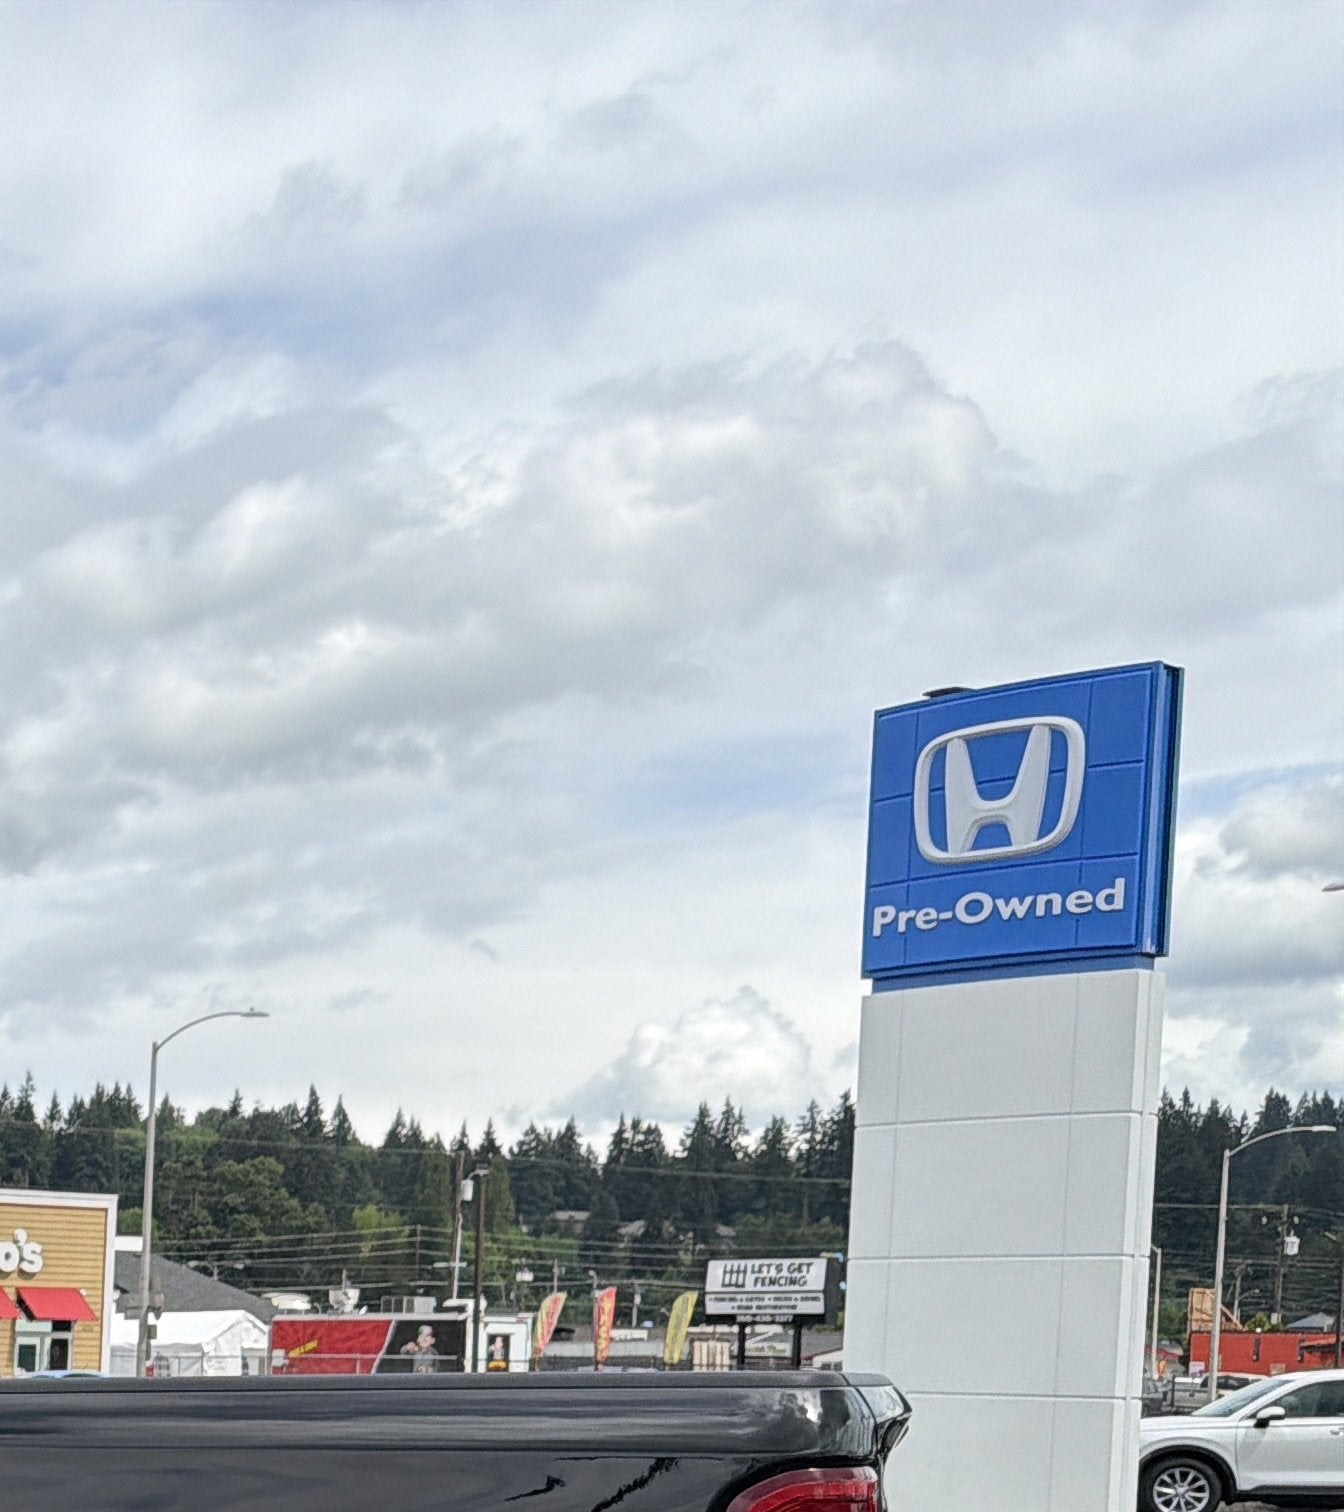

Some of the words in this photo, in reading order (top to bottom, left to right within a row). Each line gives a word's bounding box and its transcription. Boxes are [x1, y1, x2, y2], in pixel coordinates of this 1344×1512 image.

[872, 877, 1126, 937] Pre-Owned
[750, 1262, 784, 1275] LET'S
[786, 1261, 814, 1275] GET
[753, 1275, 808, 1288] FENCING
